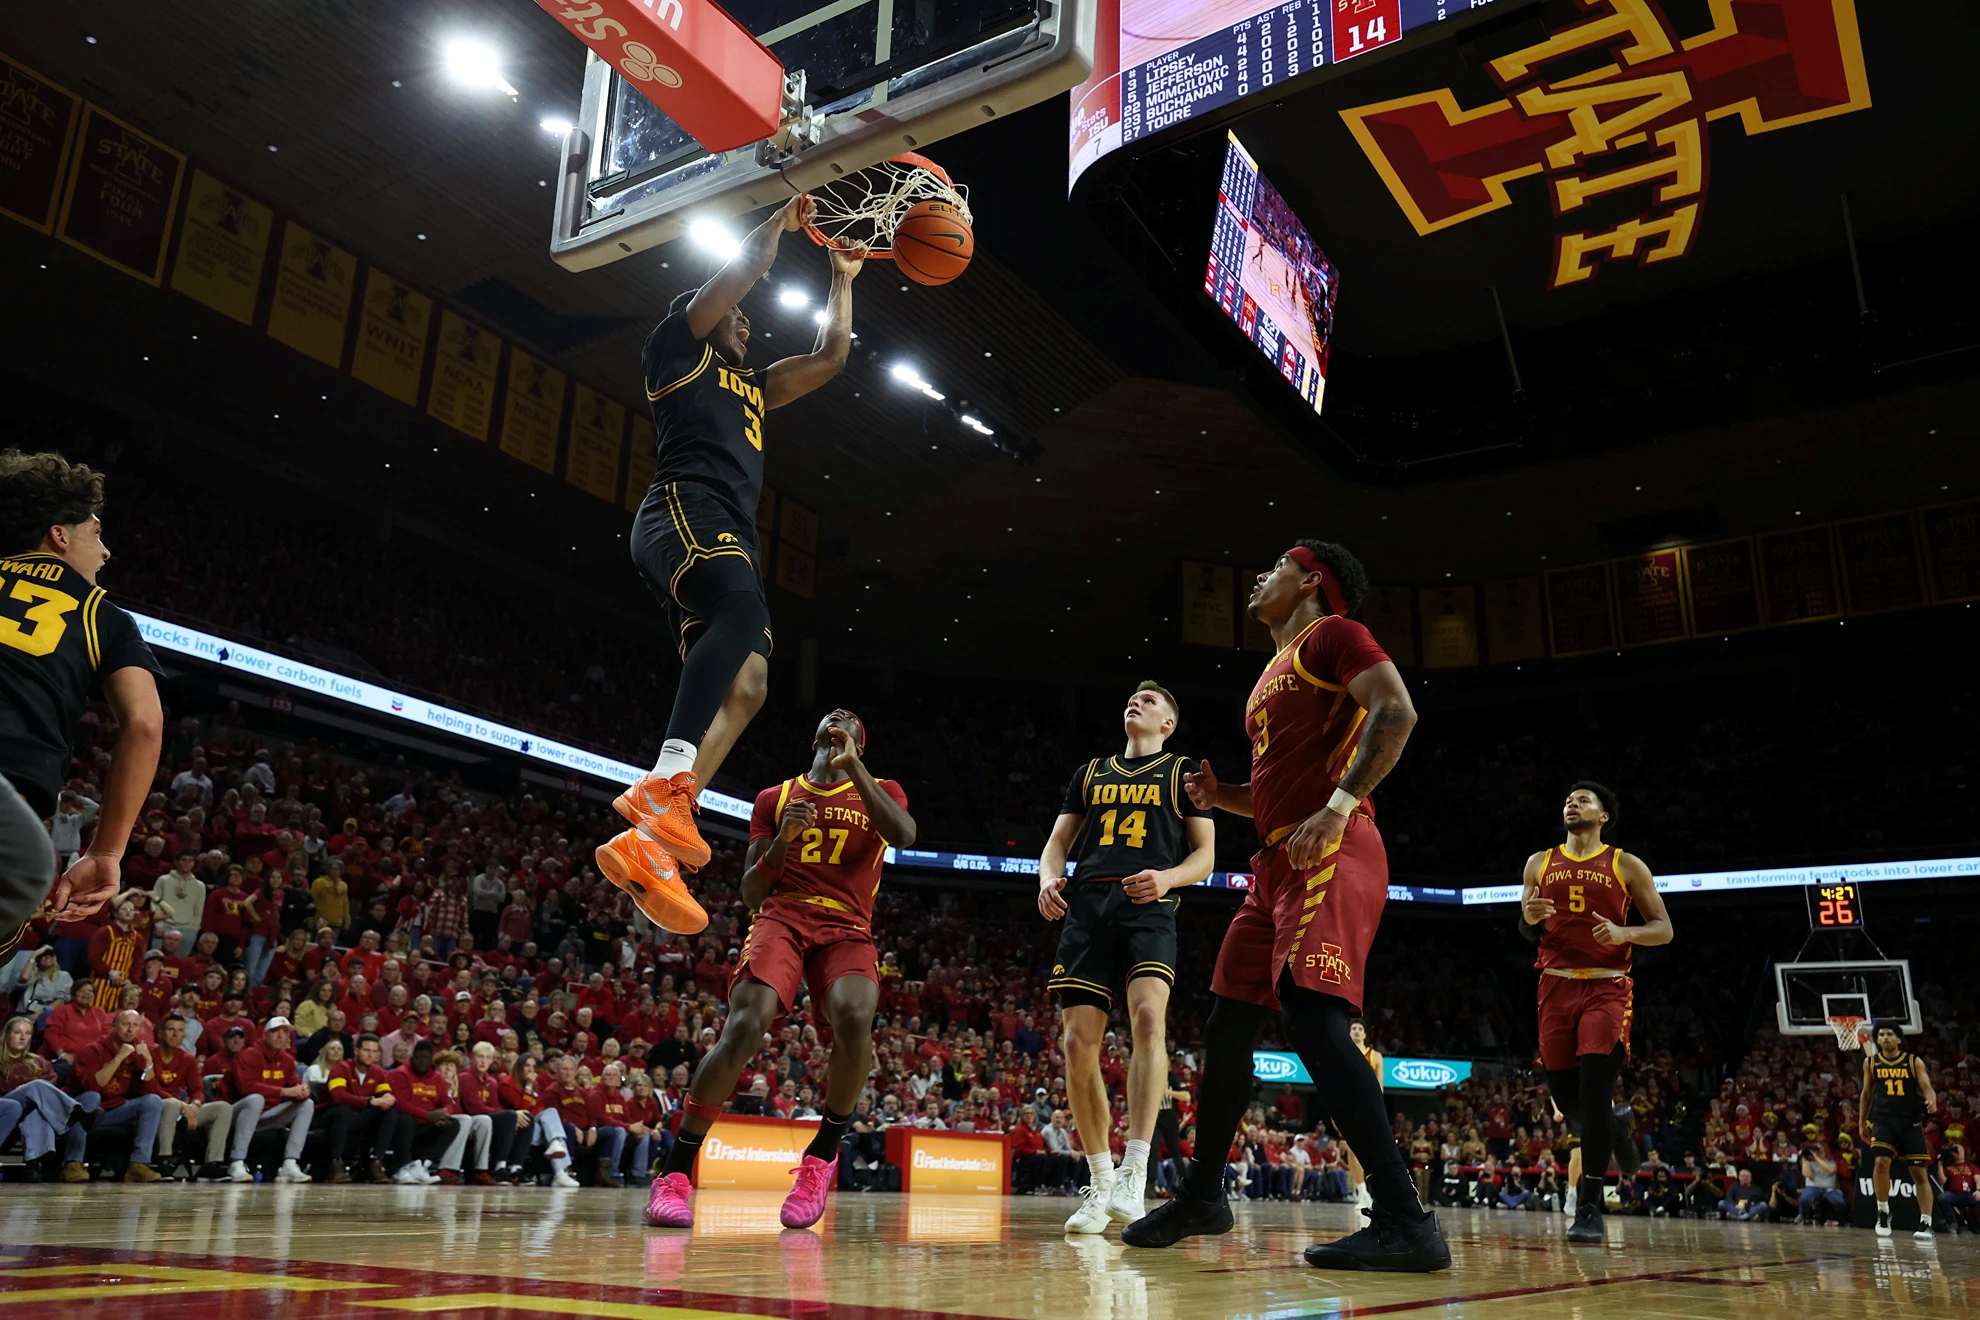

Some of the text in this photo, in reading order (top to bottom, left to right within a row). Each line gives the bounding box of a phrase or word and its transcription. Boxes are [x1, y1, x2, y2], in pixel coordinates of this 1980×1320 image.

[1146, 51, 1179, 71] PLAYER
[1233, 21, 1251, 34] PTS
[1257, 10, 1275, 25] AST
[1282, 2, 1301, 14] REB
[1146, 53, 1195, 83] LIPSEY
[1237, 32, 1247, 44] 4
[1261, 23, 1271, 36] 2
[1287, 13, 1296, 25] 1
[1312, 3, 1320, 16] 1
[1348, 16, 1387, 52] 14
[1124, 28, 1323, 117] 22 MOMCILOVIC 2 0 0 0
[1127, 16, 1320, 103] 5 JEFFERSON 4 0 2 1
[1124, 41, 1323, 129] 23 BUCHANAN 4 0 2 0
[1124, 54, 1324, 142] 27 TOURE 0 0 3 0
[366, 321, 419, 358] WNIT
[743, 403, 763, 452] 3
[230, 648, 273, 672] lower
[276, 663, 326, 688] carbon
[330, 678, 363, 699] fuels
[1262, 674, 1299, 700] STATE
[427, 708, 473, 734] helping
[476, 723, 488, 737] to
[536, 741, 567, 761] lower
[568, 752, 603, 771] carbon
[1092, 783, 1162, 807] IOWA
[824, 806, 871, 831] STATE
[1099, 809, 1147, 848] 14
[801, 828, 849, 864] 27
[1545, 869, 1612, 888] IOWA STATE
[1726, 871, 1806, 886] transforming
[1884, 866, 1911, 876] into
[1914, 862, 1954, 875] lower
[1490, 890, 1519, 898] lower
[1569, 885, 1586, 912] 5
[1821, 886, 1853, 900] 4:27
[1819, 901, 1853, 925] 26
[1306, 954, 1351, 981] STATE
[1398, 1062, 1452, 1082] Sukup
[1877, 1068, 1909, 1079] IOWA
[1885, 1079, 1905, 1096] 11
[721, 1145, 798, 1163] First Interstate
